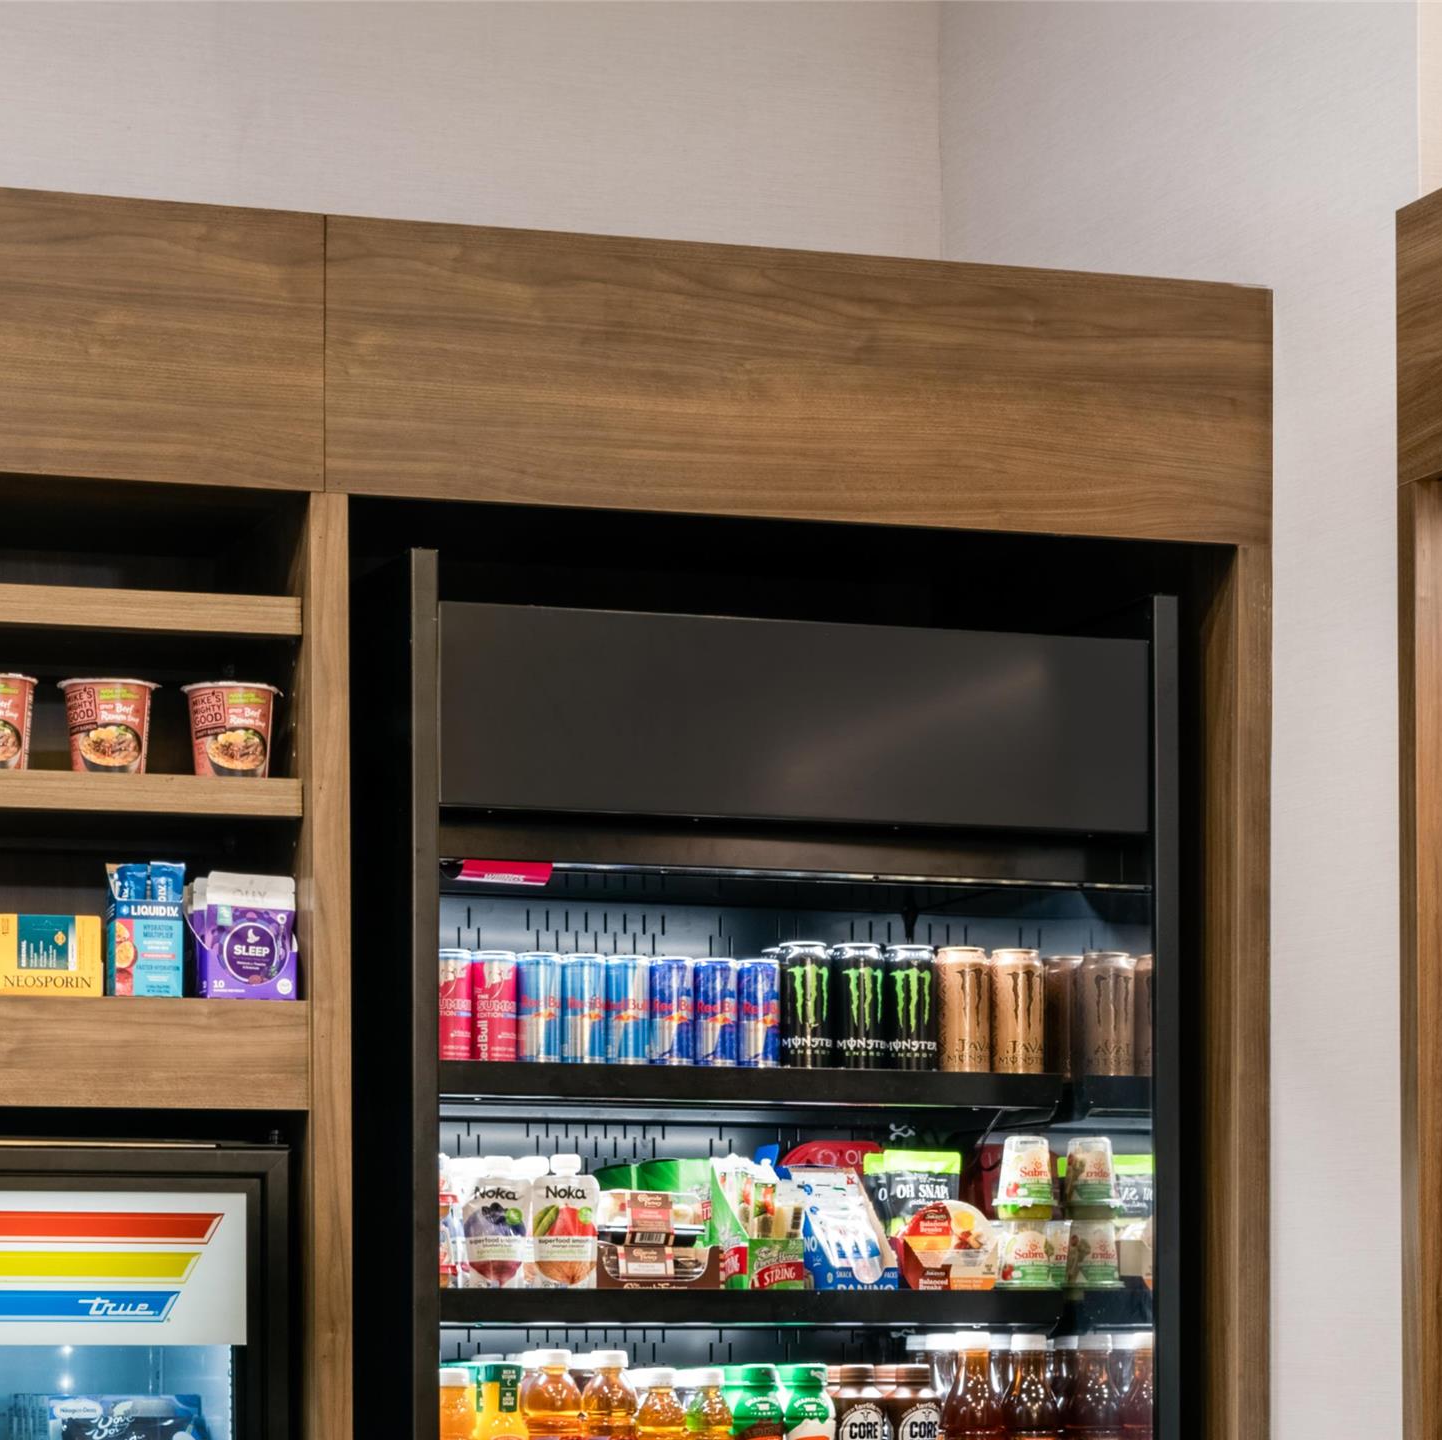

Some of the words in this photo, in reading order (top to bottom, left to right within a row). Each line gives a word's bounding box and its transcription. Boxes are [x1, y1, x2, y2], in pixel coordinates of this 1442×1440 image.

[194, 713, 223, 725] GOOD
[233, 944, 270, 957] SLEEP
[4, 974, 91, 988] NEOSPORIN
[1019, 1166, 1049, 1178] Sabra
[473, 1186, 518, 1201] Noka
[545, 1186, 587, 1200] Noka
[763, 1269, 796, 1286] STRING
[849, 1422, 878, 1439] CORE
